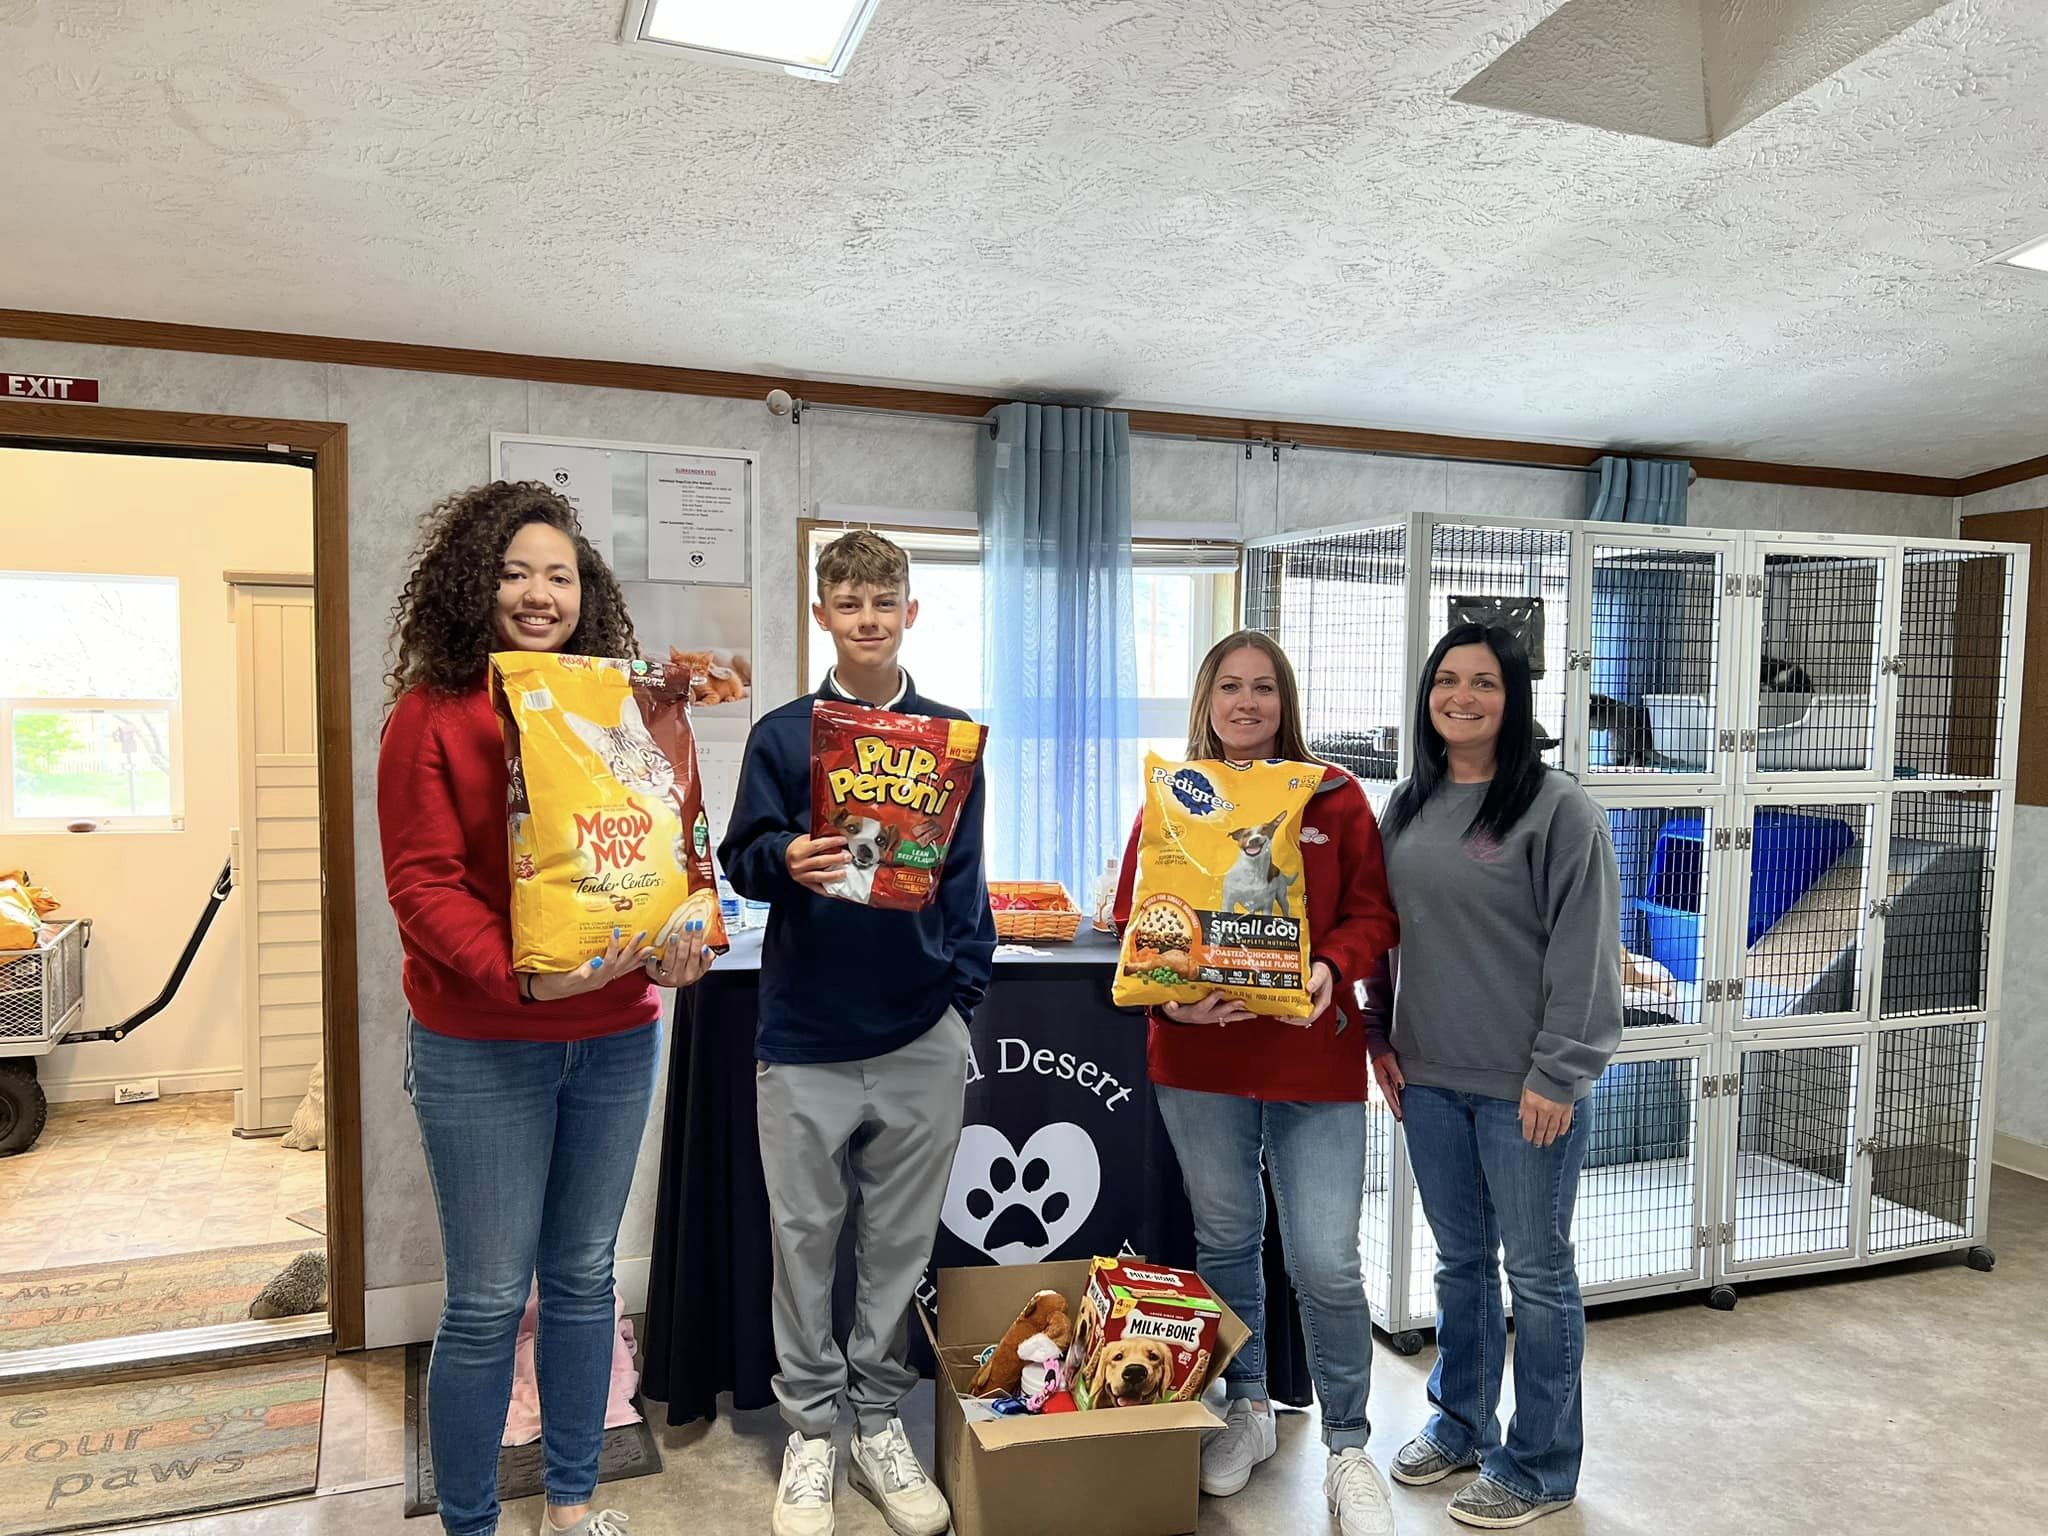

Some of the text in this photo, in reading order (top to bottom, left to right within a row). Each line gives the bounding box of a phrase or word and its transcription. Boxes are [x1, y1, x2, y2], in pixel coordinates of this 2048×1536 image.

[8, 375, 73, 399] EXIT
[828, 768, 955, 816] Peroni
[1150, 766, 1235, 812] Pedigree
[572, 796, 653, 849] Meow
[911, 849, 930, 857] LEAN
[571, 872, 661, 894] Tender Centers
[1211, 919, 1298, 940] small dog
[1247, 951, 1283, 961] CHICKEN,
[1274, 961, 1299, 969] FLAVOR
[997, 1038, 1135, 1112] Desert
[46, 1450, 244, 1511] paws
